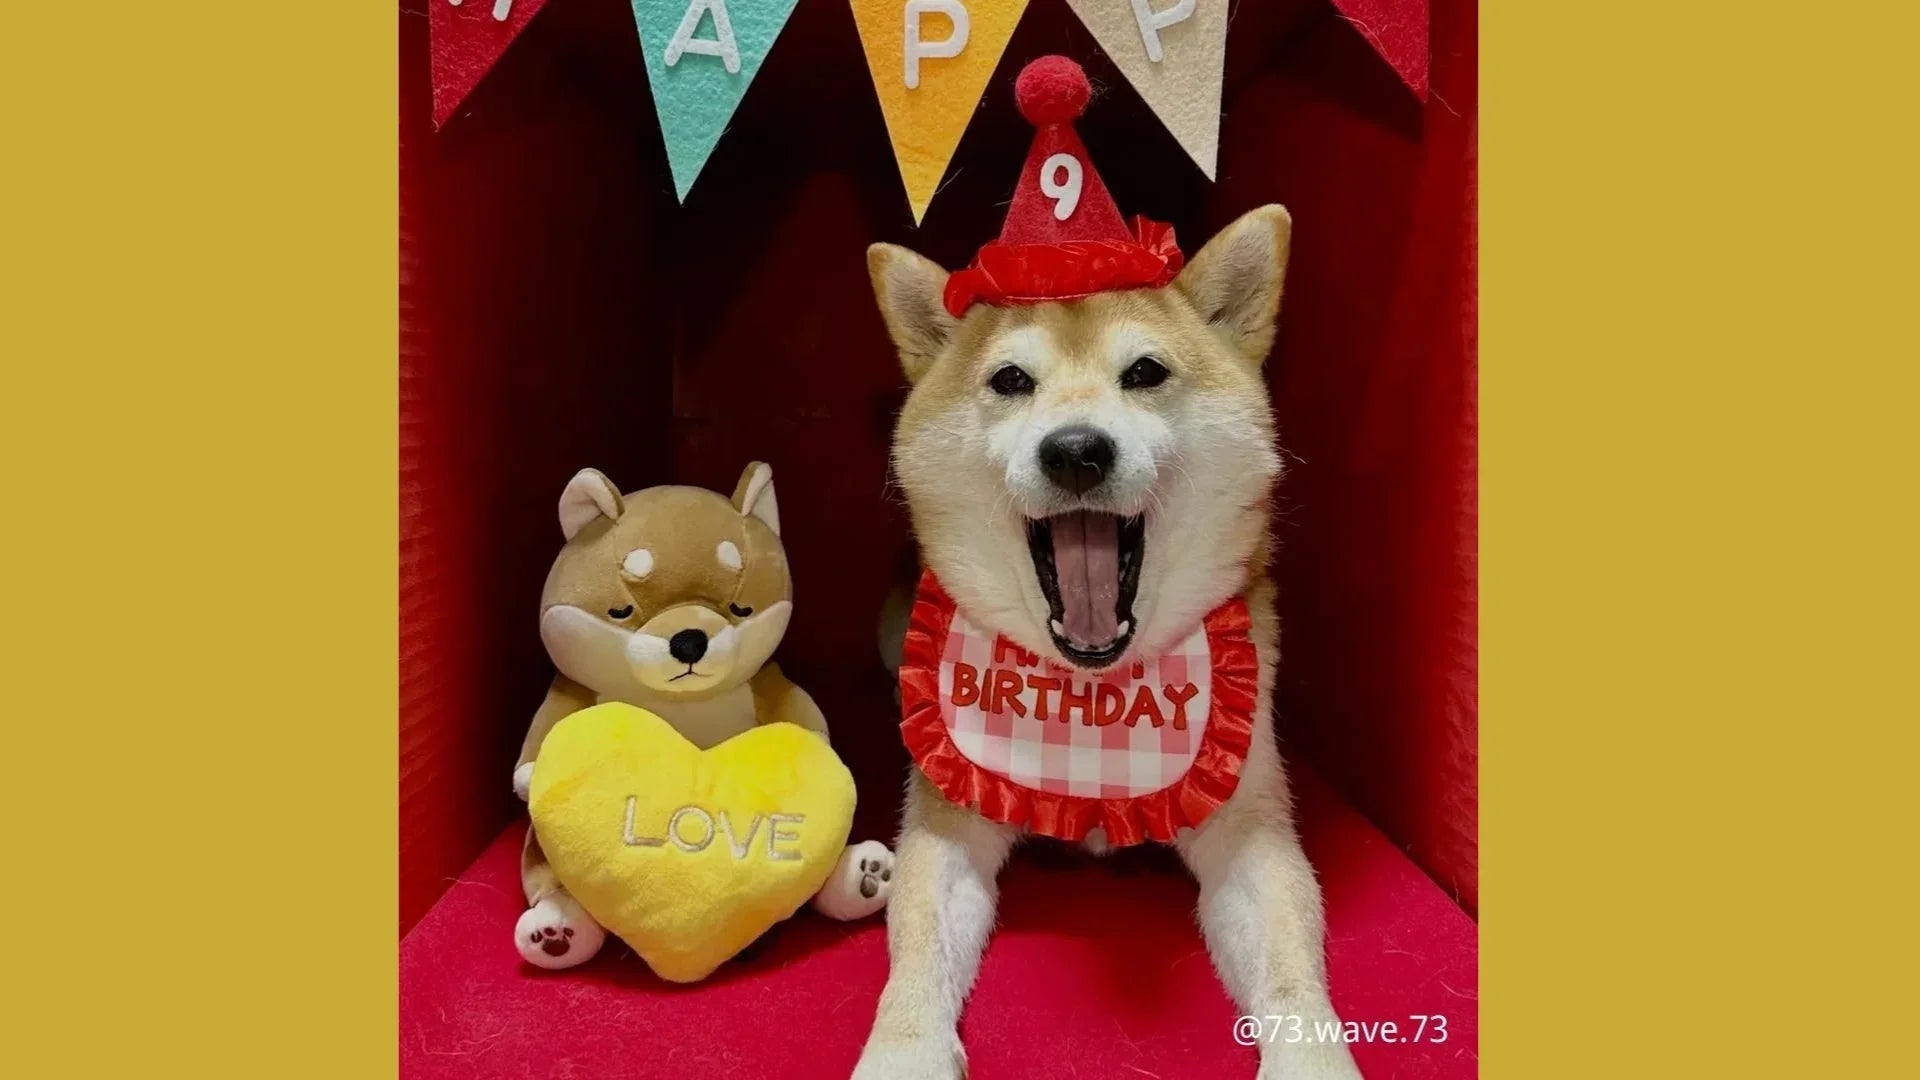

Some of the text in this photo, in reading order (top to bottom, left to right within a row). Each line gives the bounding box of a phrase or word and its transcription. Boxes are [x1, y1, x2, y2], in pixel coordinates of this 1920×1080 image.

[1039, 153, 1083, 221] 9
[951, 662, 1199, 730] BIRTHDAY
[622, 794, 805, 861] LOVE
